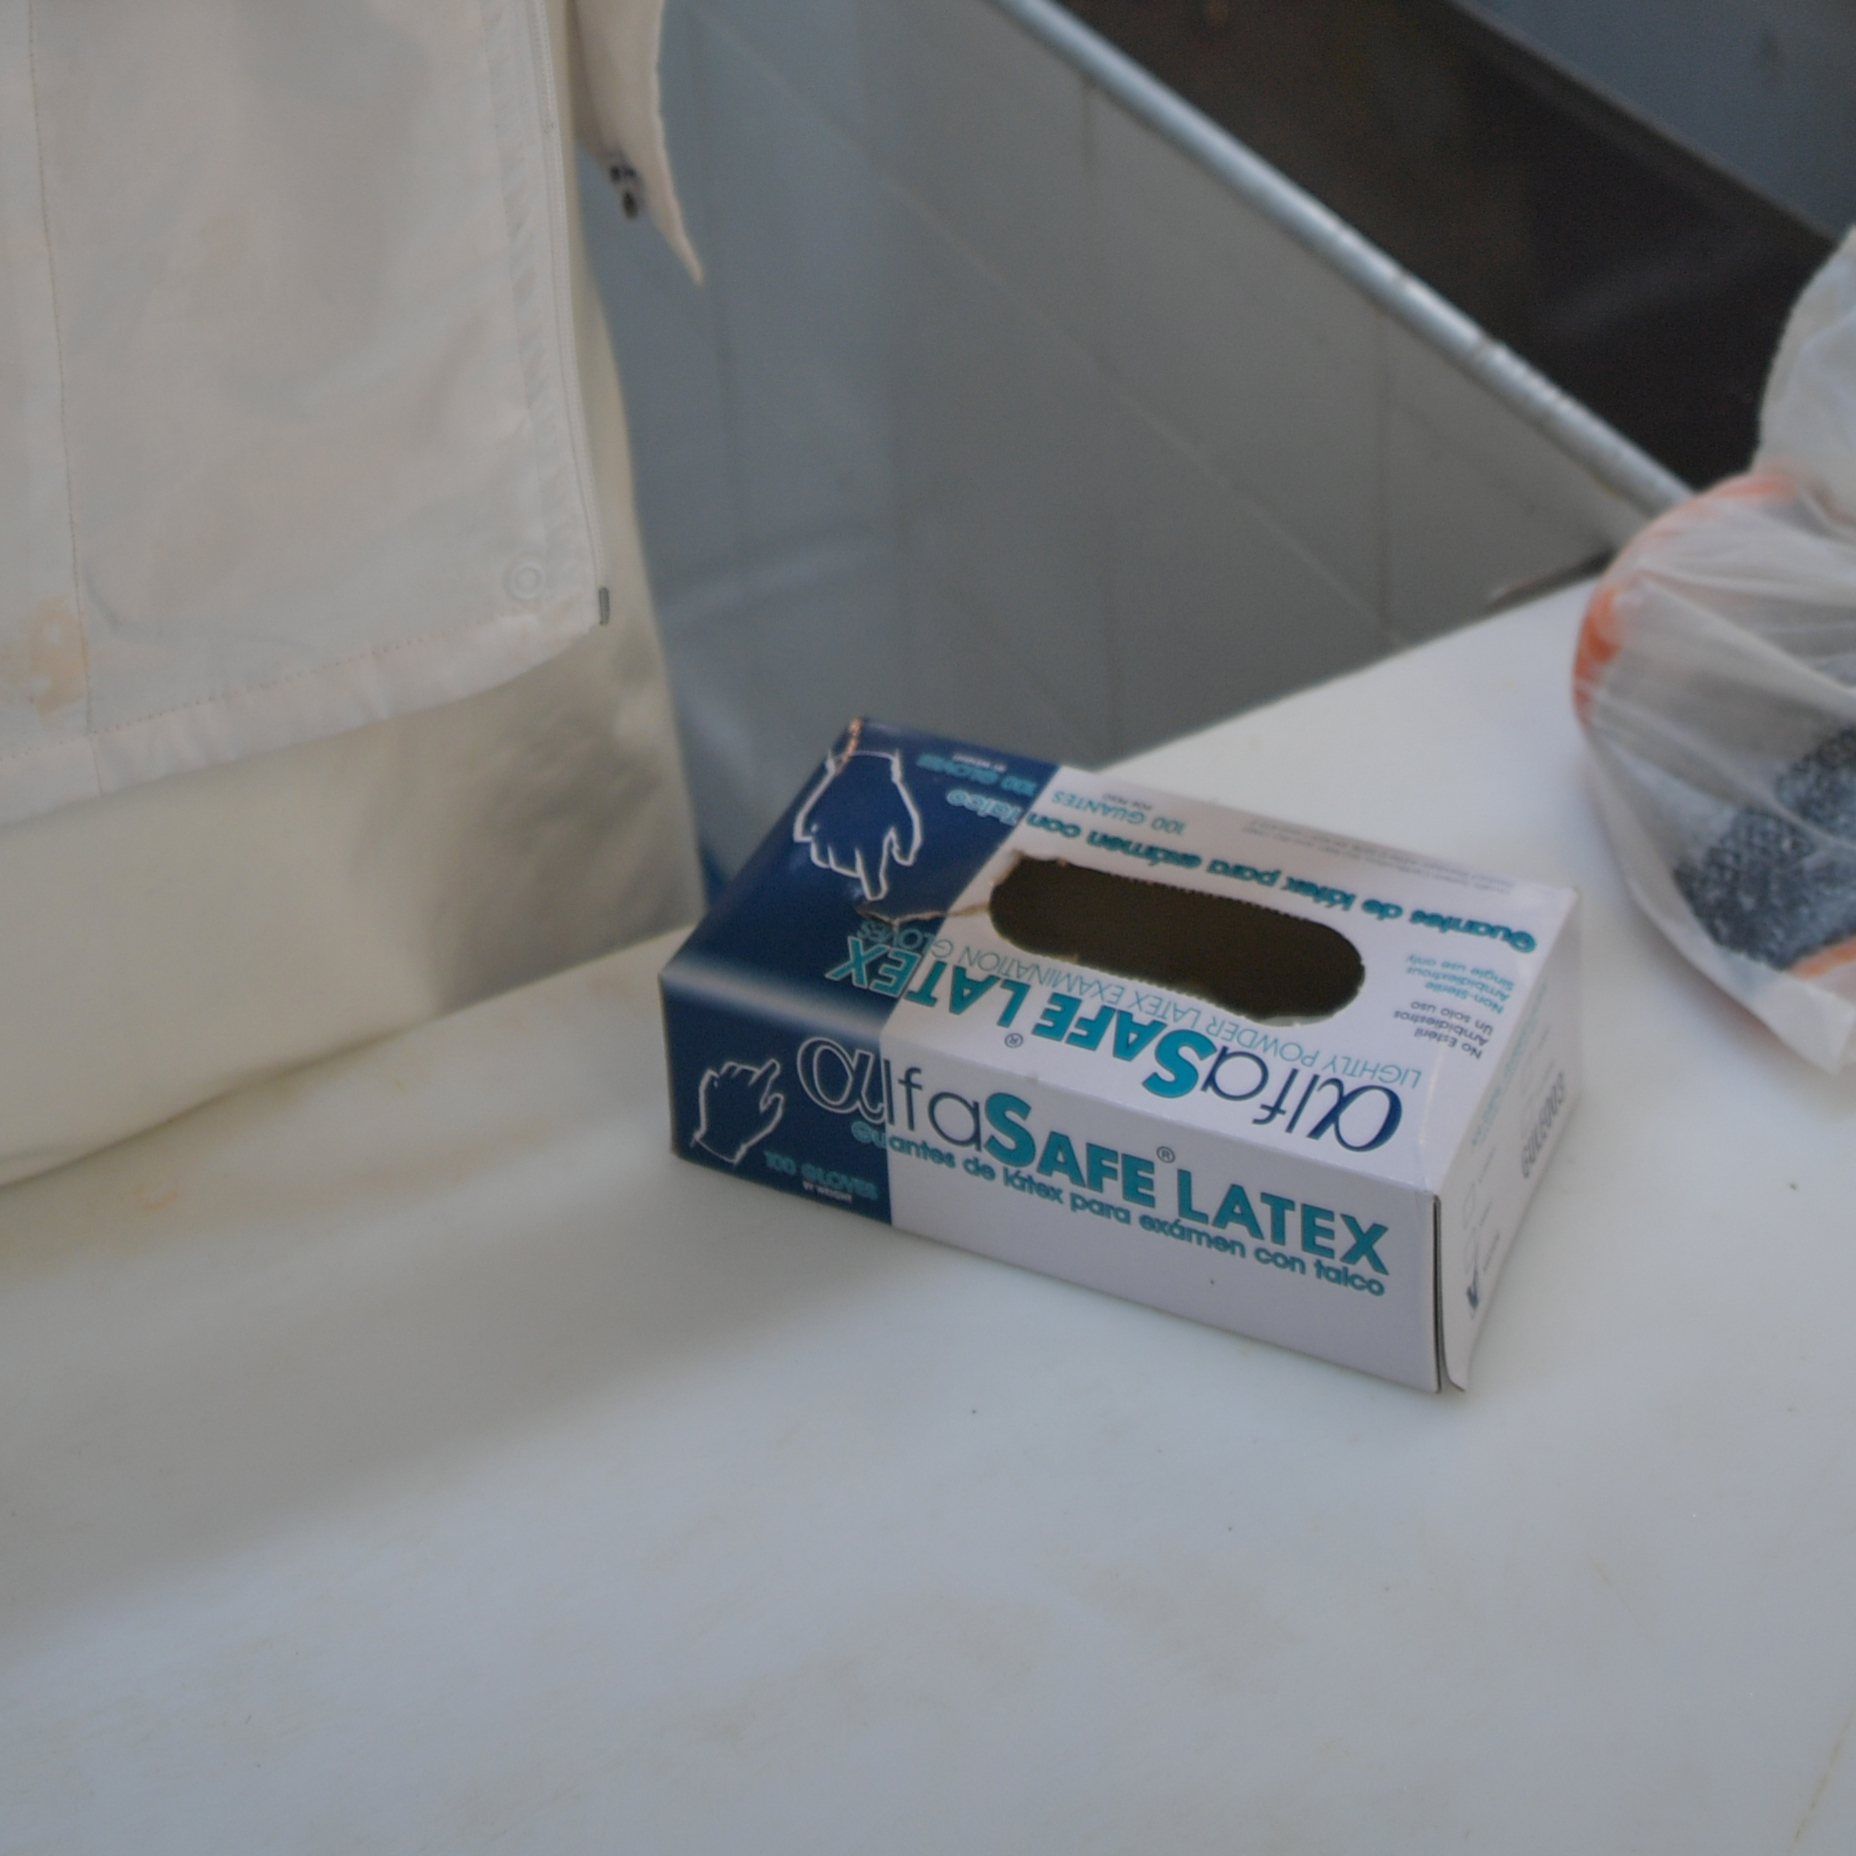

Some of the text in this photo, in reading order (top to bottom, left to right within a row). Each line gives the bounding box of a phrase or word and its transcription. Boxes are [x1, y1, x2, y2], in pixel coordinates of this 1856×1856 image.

[1025, 811, 1082, 839] con
[1050, 790, 1187, 836] 100 GUANTES
[1206, 859, 1282, 886] para
[1283, 875, 1357, 912] látex
[1360, 898, 1403, 921] de
[1409, 909, 1537, 954] Guantes
[824, 935, 1032, 1029] LATEX
[960, 945, 1125, 1006] EXAMINATION
[1126, 989, 1202, 1025] LATEX
[1411, 1001, 1493, 1035] Un solo uso
[1206, 1015, 1321, 1069] POWDER
[1462, 1043, 1482, 1059] No
[1322, 1055, 1422, 1090] LIGHTLY
[801, 1162, 879, 1201] GLOVES
[850, 1120, 1386, 1297] Guantes de látex para exámen con talco
[1176, 1167, 1390, 1277] LATEX
